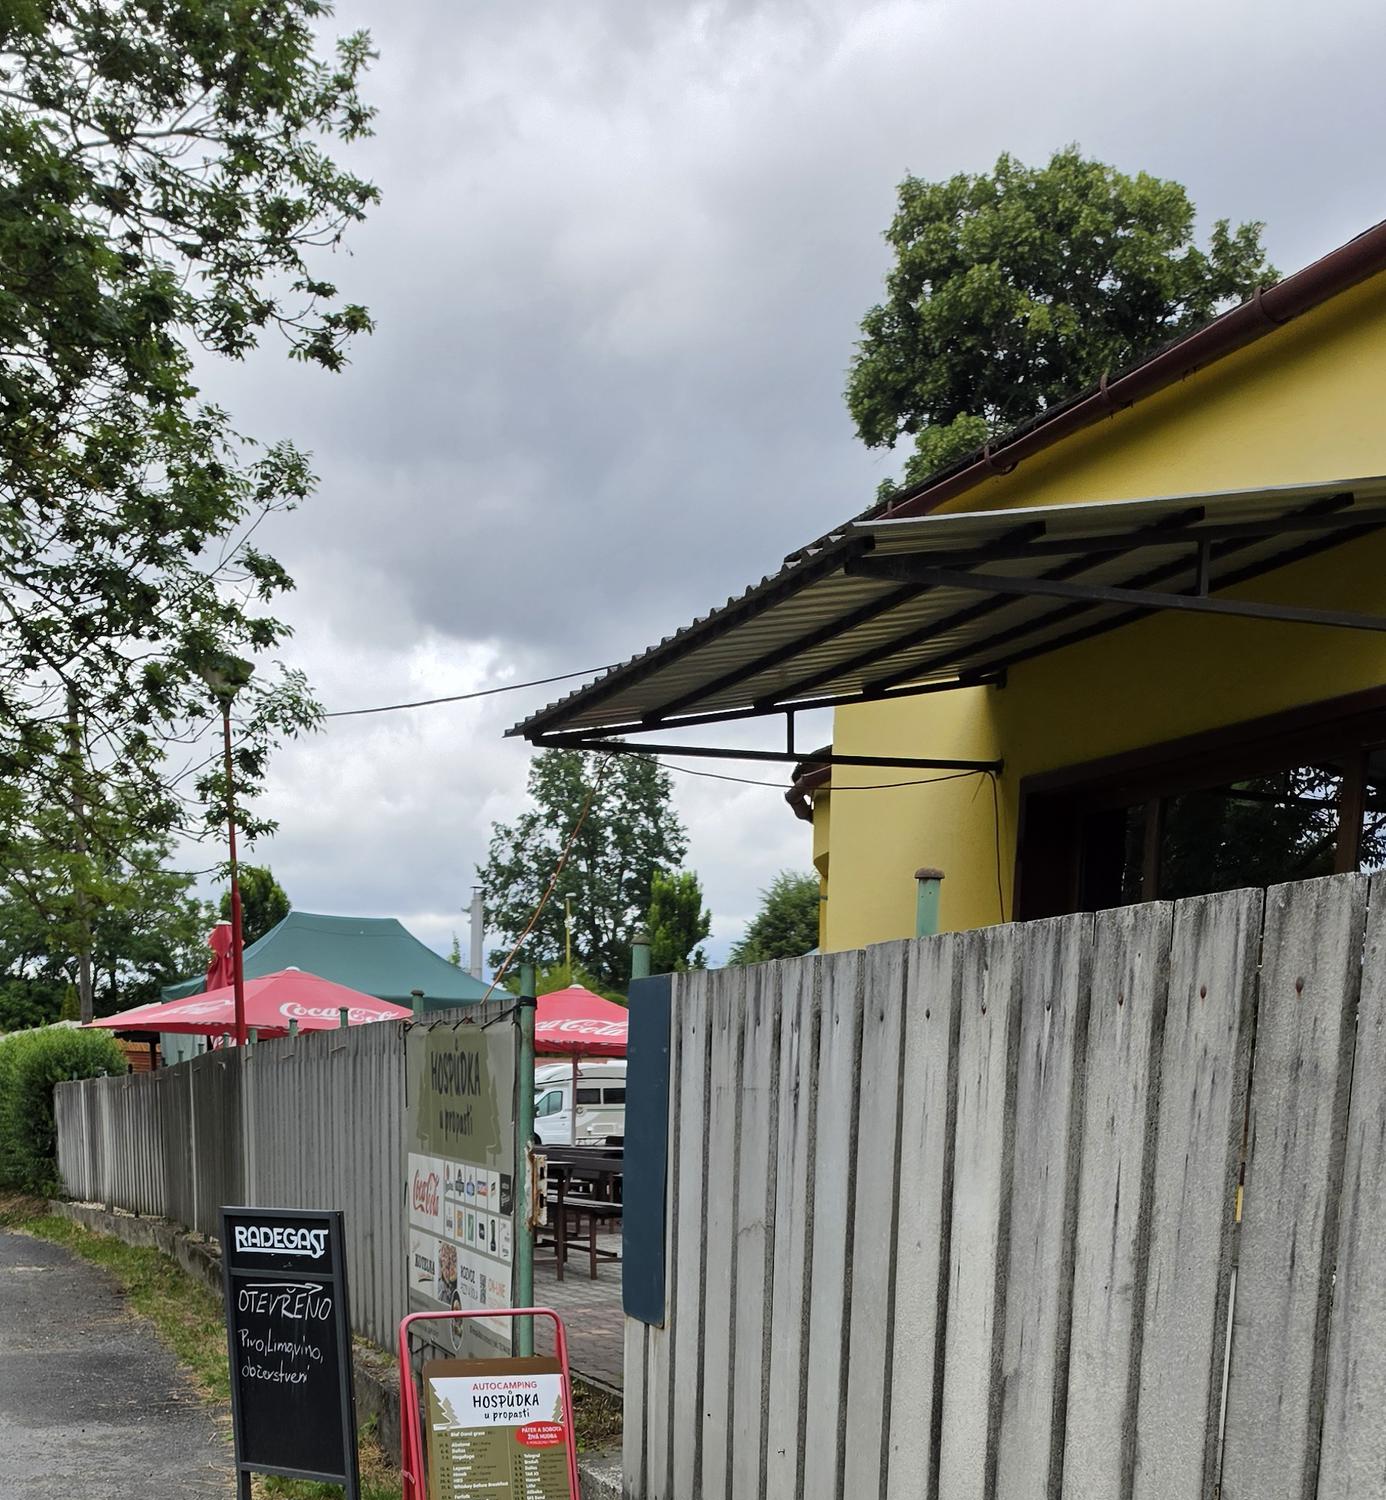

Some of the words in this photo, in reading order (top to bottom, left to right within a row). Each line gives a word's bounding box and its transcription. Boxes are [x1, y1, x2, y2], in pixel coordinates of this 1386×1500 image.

[235, 1226, 329, 1259] RADEGAST
[238, 1288, 332, 1321] OTEVŘENO
[473, 1381, 537, 1391] AUTOCAMPING
[473, 1390, 540, 1409] HOSPŮDKA
[493, 1408, 530, 1422] propasti
